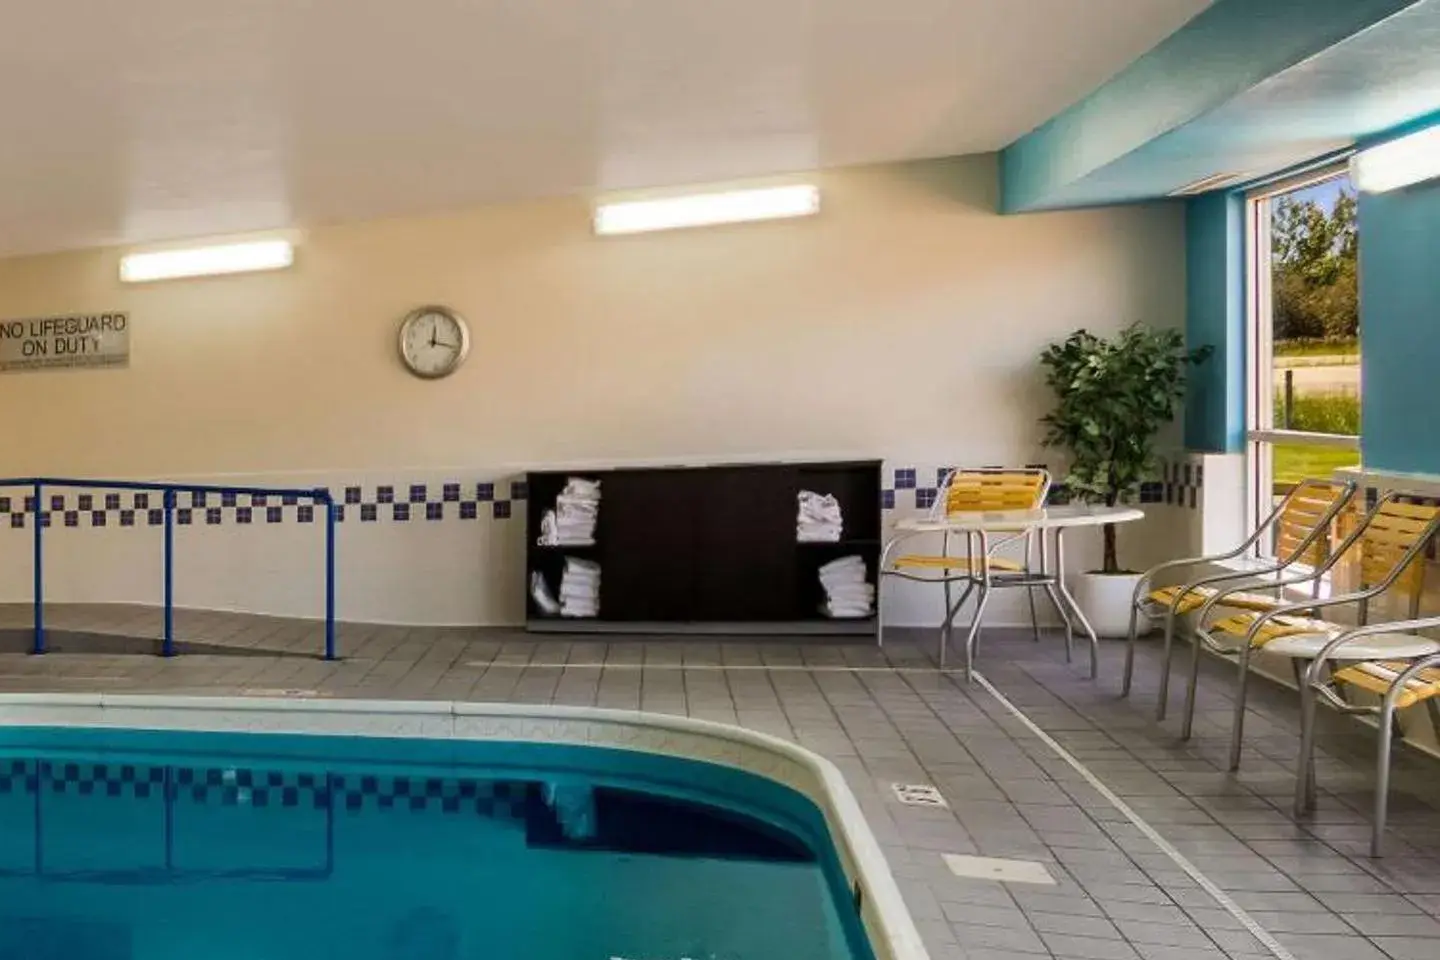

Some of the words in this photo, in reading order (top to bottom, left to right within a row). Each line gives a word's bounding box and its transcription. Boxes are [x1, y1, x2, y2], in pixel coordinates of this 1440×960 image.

[0, 322, 24, 339] NO
[30, 314, 126, 337] LIFEGUARD
[22, 340, 47, 356] ON
